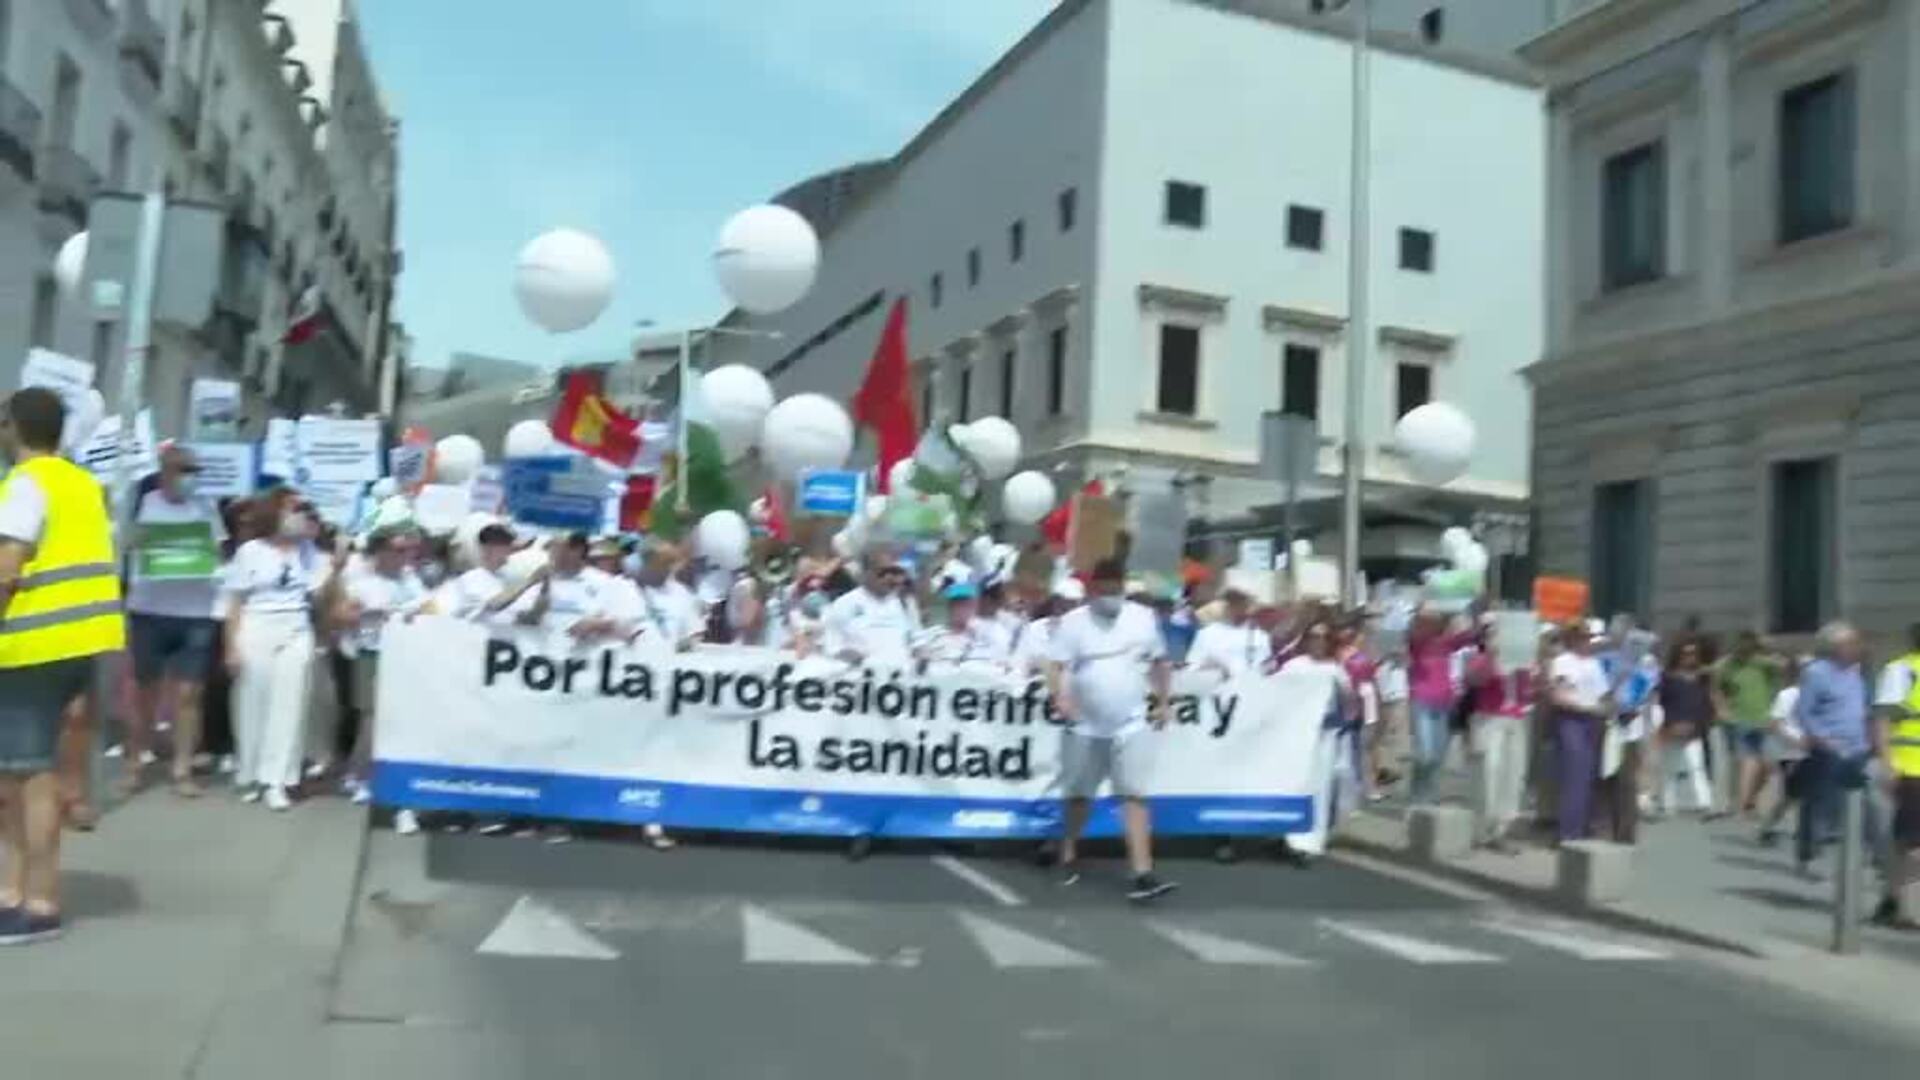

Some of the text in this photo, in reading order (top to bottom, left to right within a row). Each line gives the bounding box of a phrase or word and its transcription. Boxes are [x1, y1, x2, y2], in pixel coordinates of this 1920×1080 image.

[484, 638, 1239, 738] Por la profesión enfea y
[748, 719, 1032, 782] la sanidad
